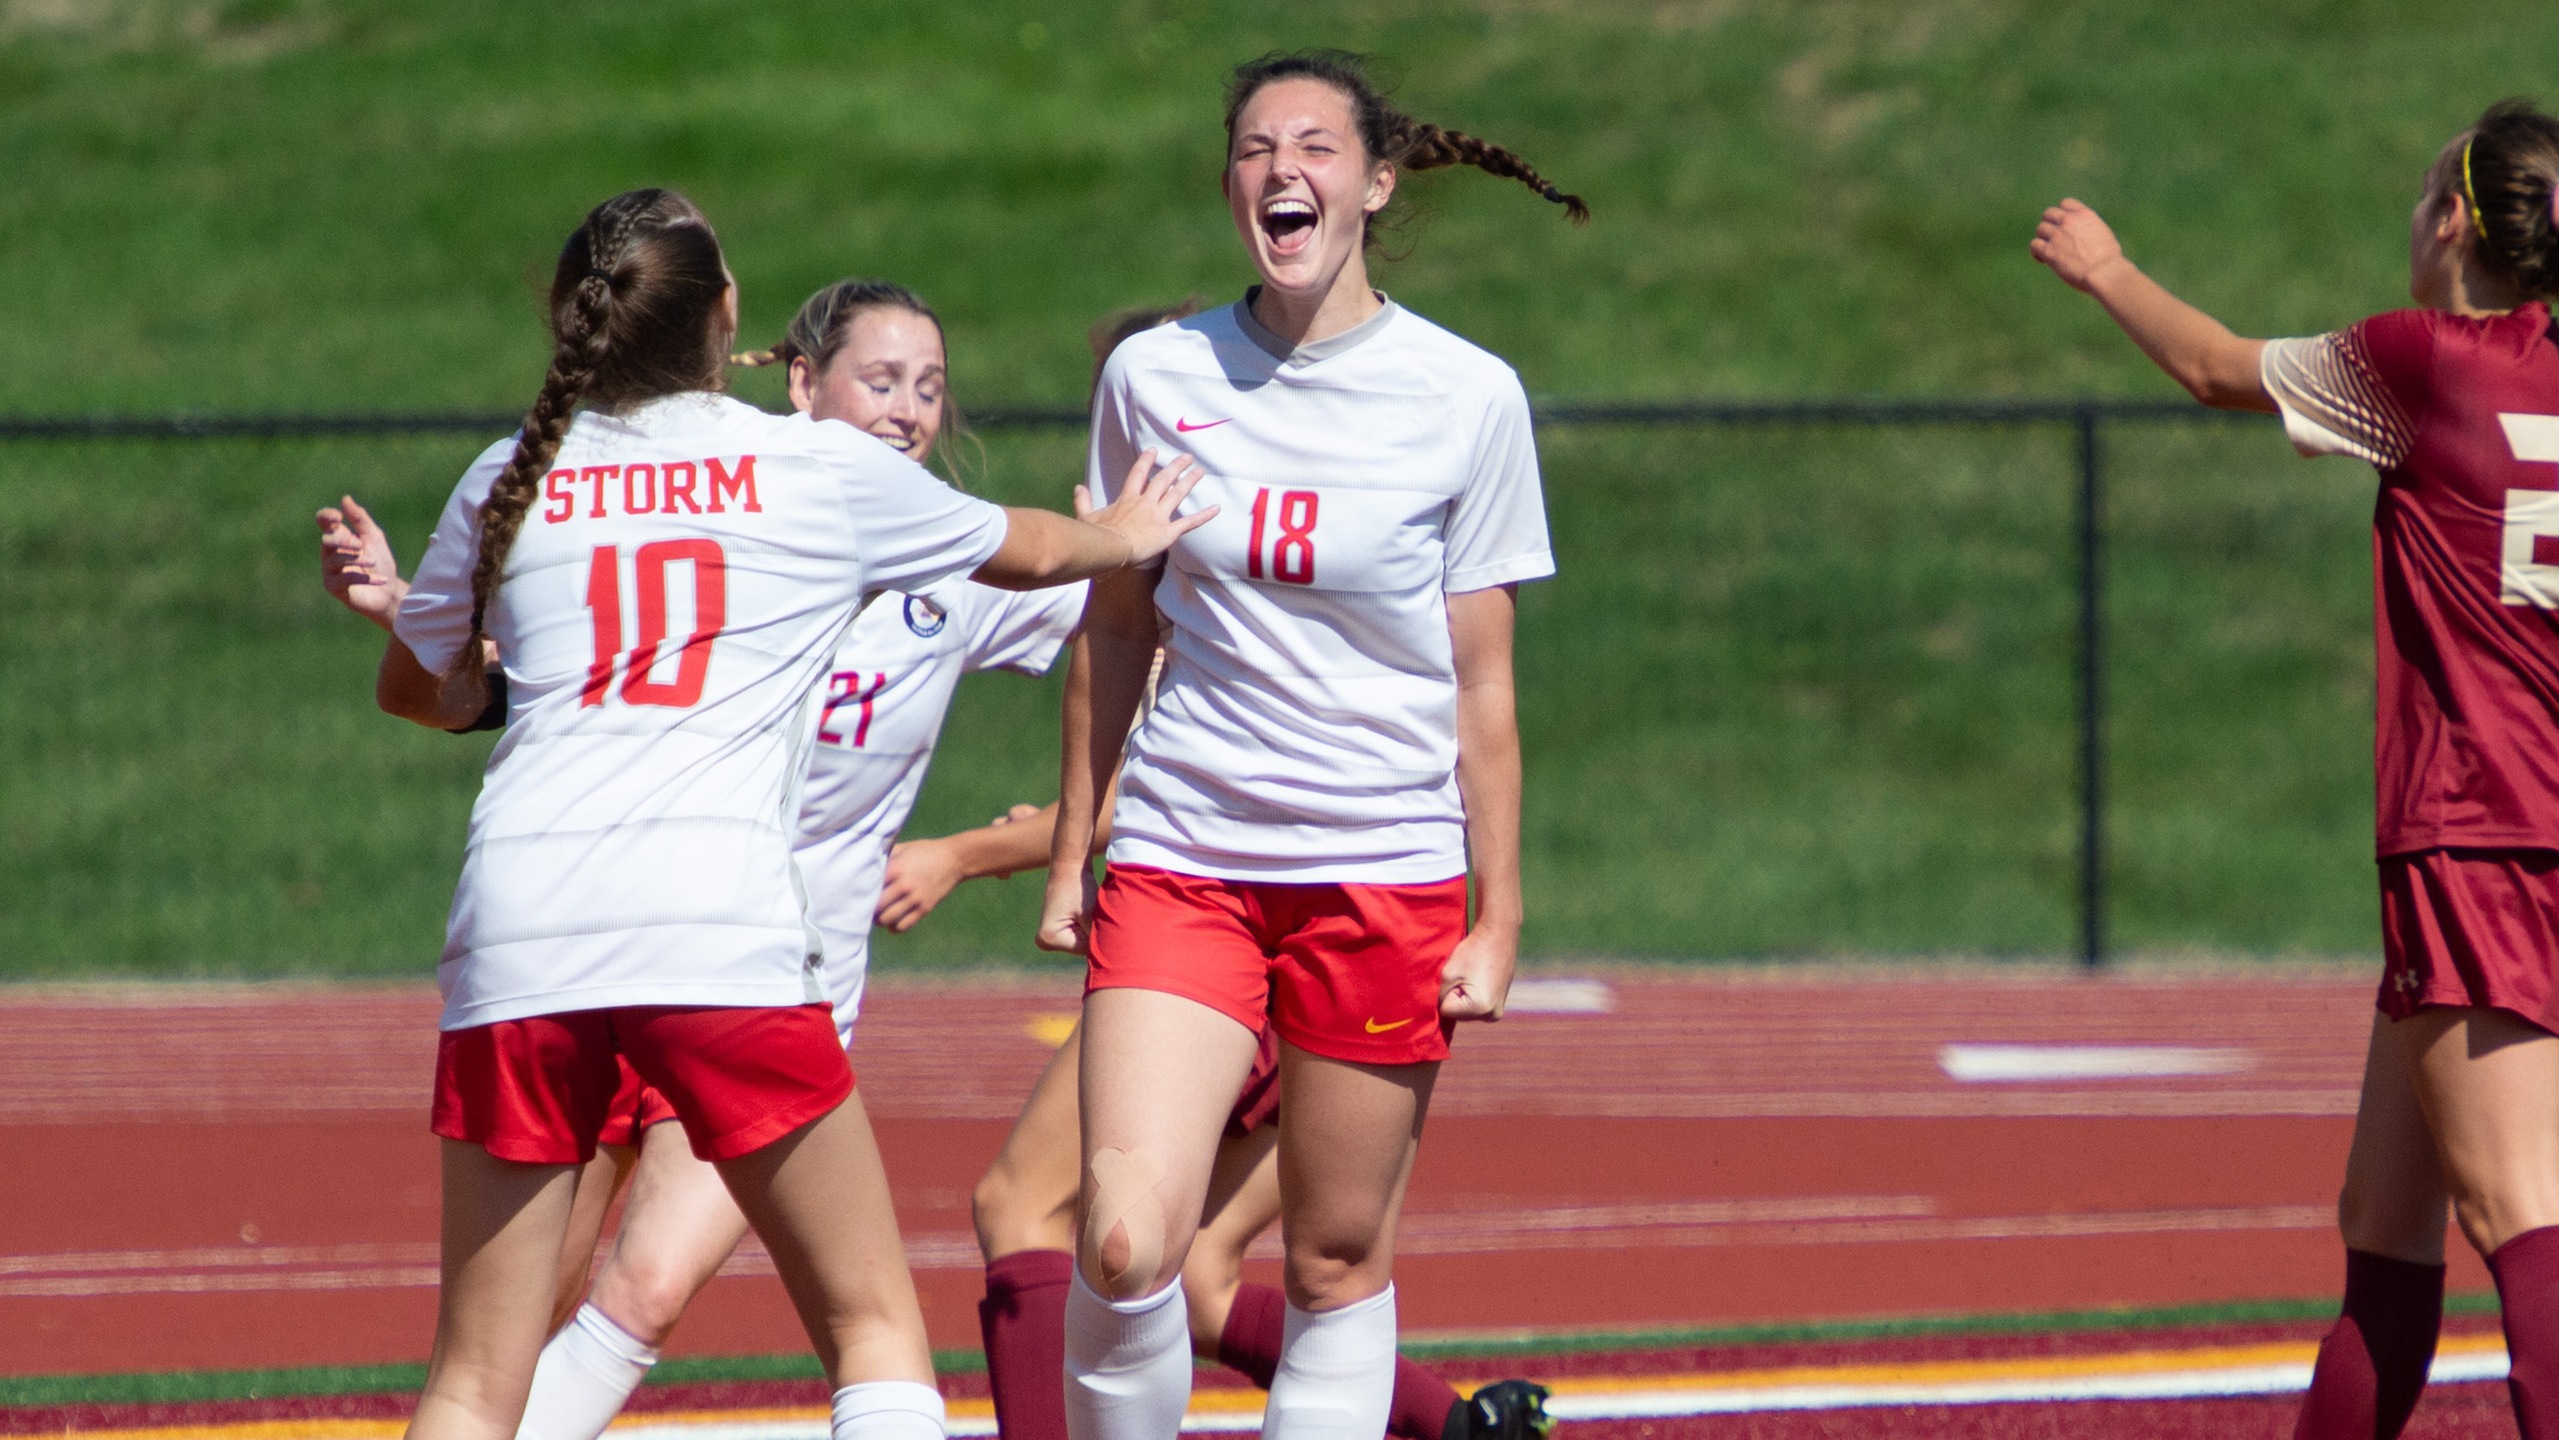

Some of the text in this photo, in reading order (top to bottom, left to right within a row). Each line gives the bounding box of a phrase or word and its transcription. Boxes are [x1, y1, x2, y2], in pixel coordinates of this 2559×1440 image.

[544, 455, 762, 524] STORM
[1248, 487, 1319, 586] 18
[580, 537, 728, 709] 10
[817, 671, 886, 748] 21
